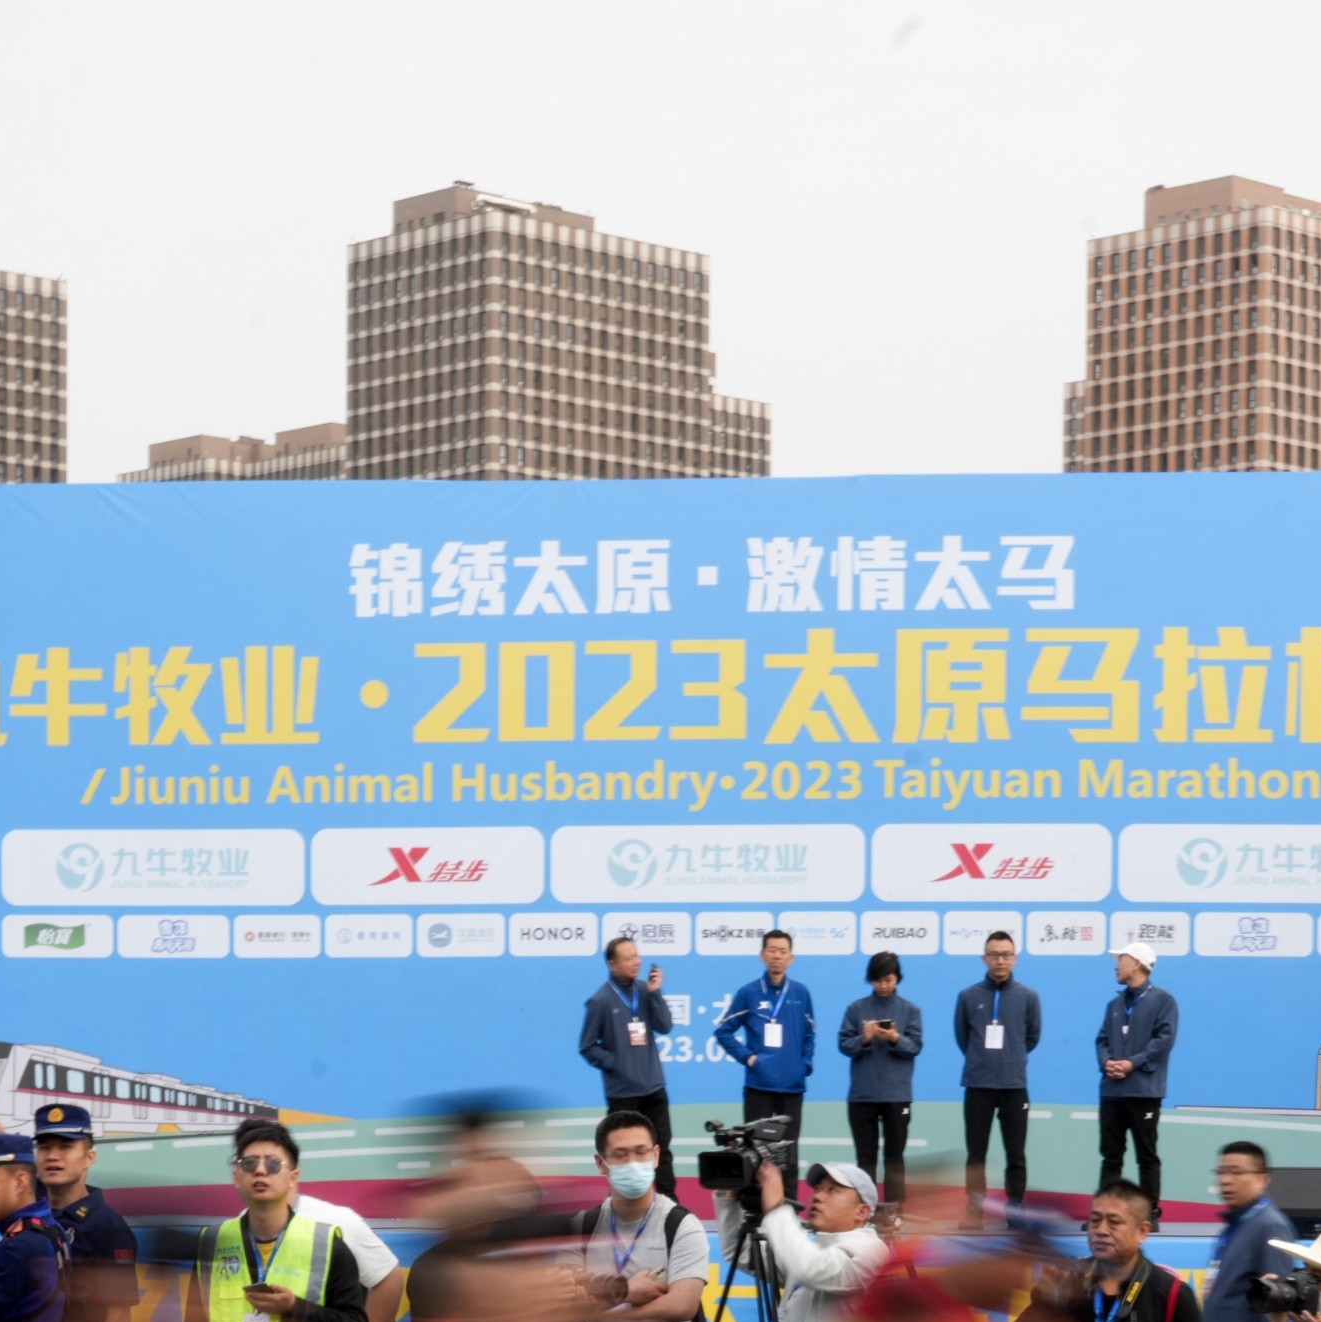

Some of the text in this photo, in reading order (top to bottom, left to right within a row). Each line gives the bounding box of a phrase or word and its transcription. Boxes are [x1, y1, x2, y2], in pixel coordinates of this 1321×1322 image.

[348, 535, 1077, 619] 锦绣太原·激情太马
[266, 761, 434, 804] Animal
[874, 758, 1062, 811] Taiyuan
[111, 847, 251, 876] 九牛牧业
[664, 843, 809, 873] 九牛牧业
[520, 927, 586, 941] HONOR
[641, 923, 675, 938] 启辰
[702, 927, 743, 940] SHOKZ
[873, 926, 928, 939] RUIBAO
